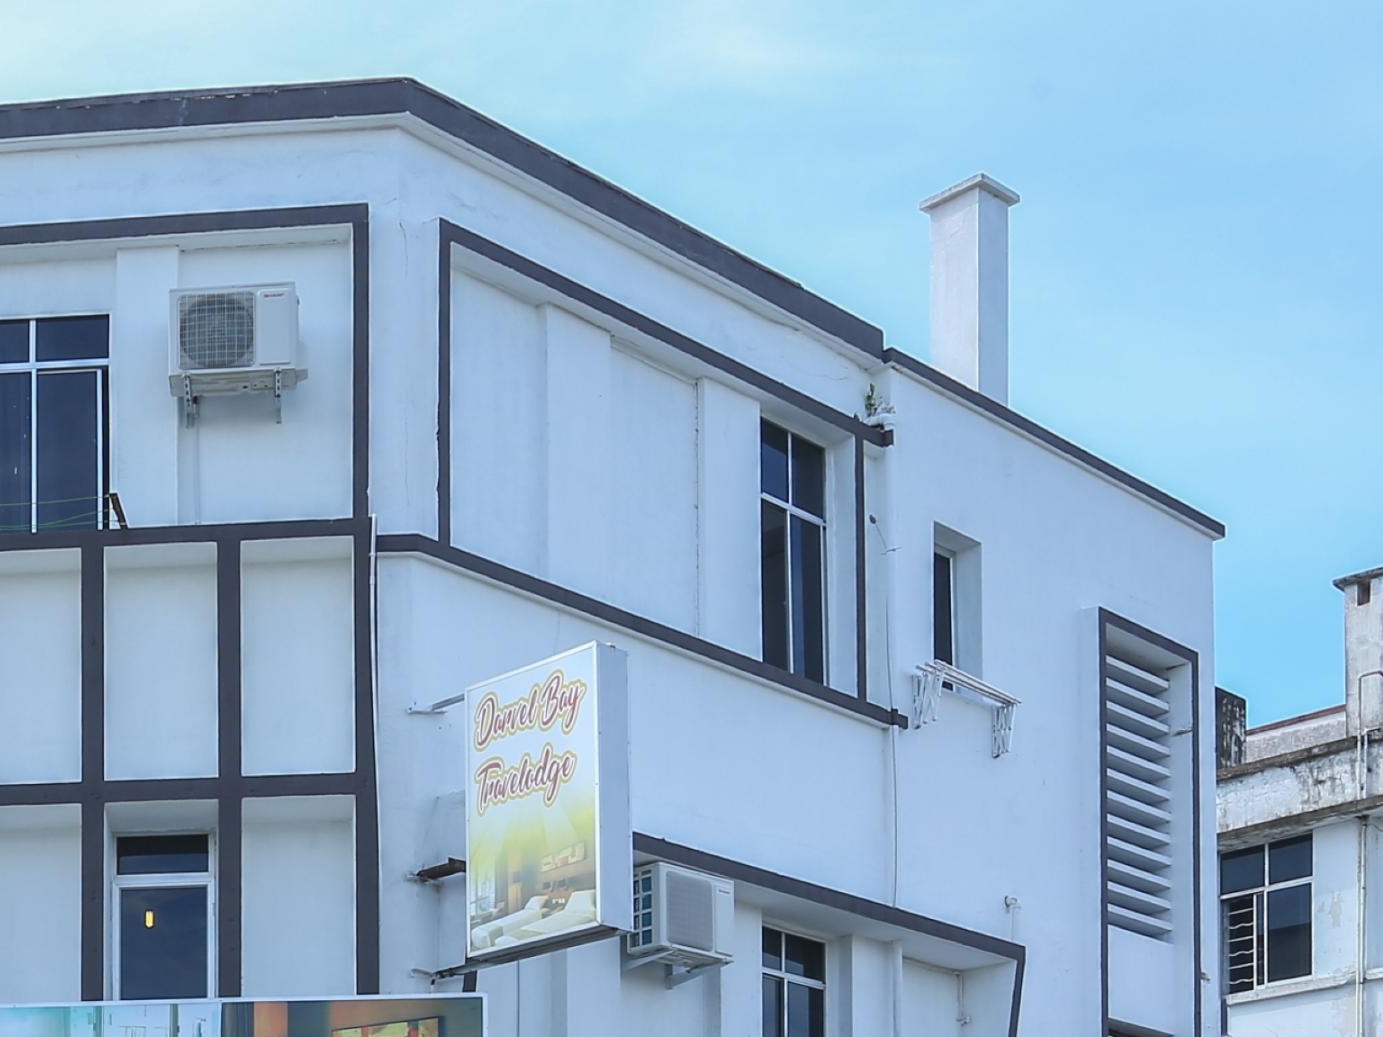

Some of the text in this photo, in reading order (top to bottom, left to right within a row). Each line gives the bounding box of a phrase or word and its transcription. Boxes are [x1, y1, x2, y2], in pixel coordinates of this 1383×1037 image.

[477, 673, 584, 747] Darvel Bay
[476, 747, 575, 813] Travelodge
